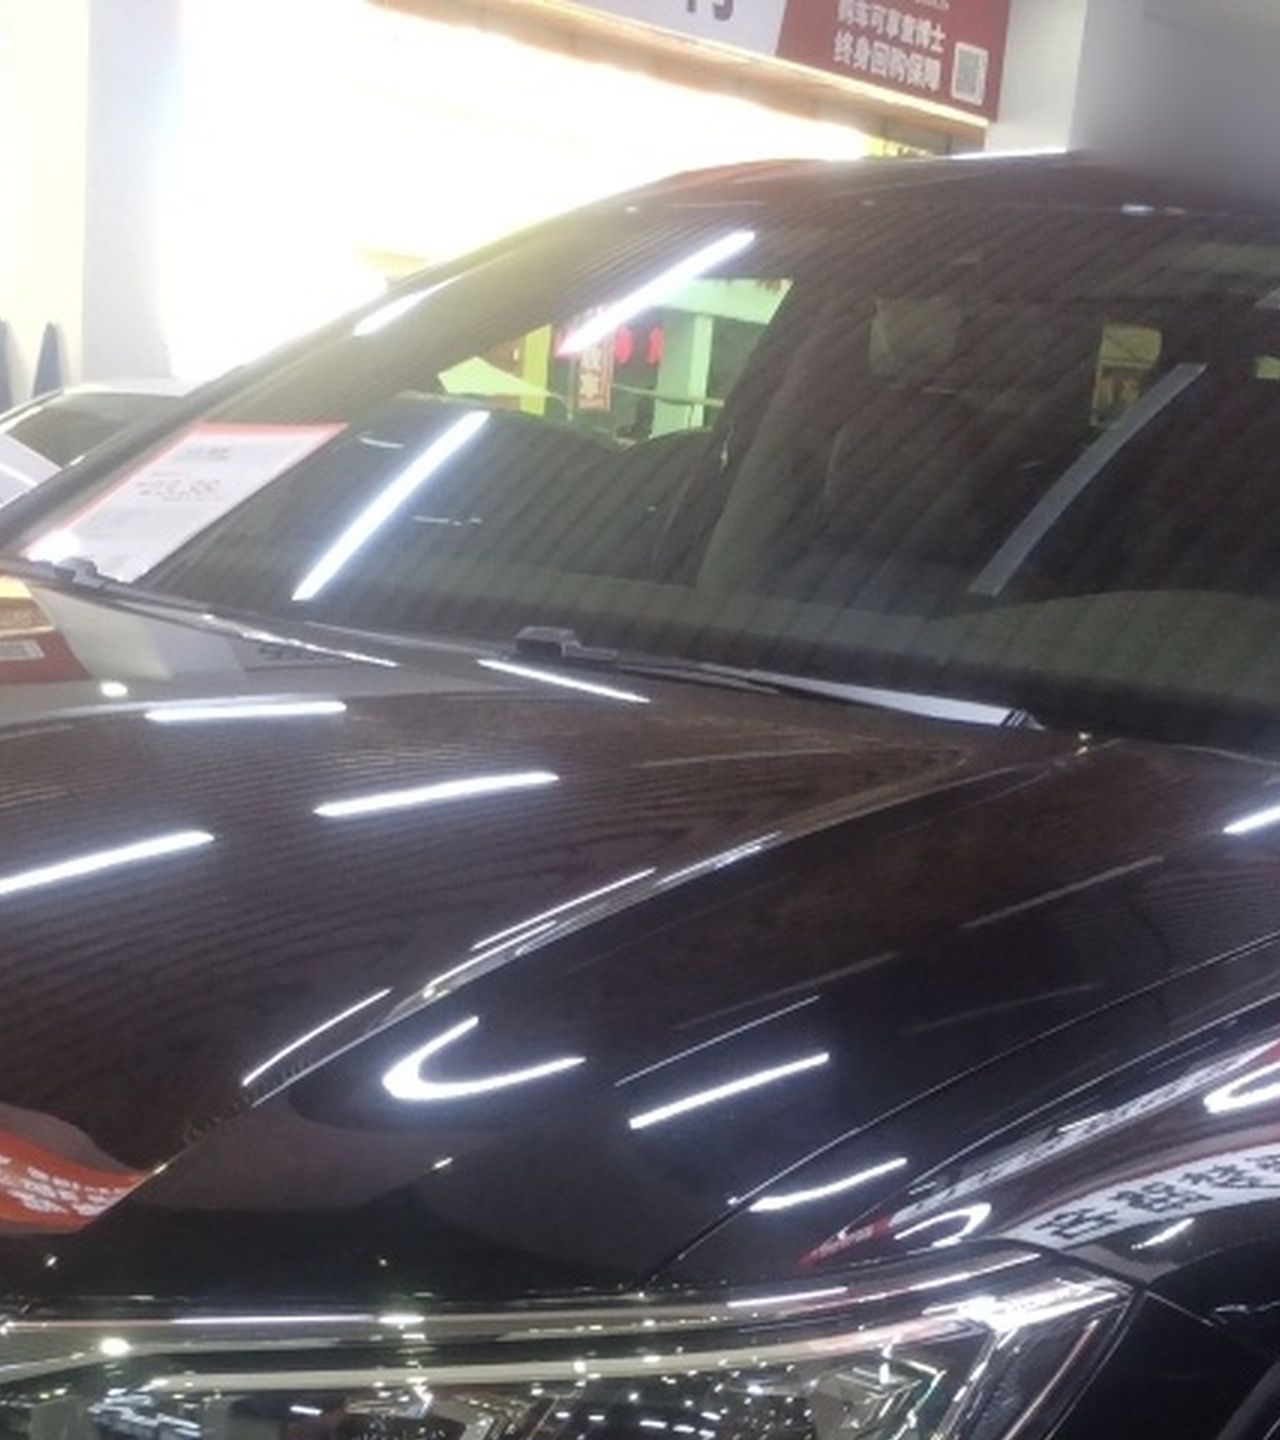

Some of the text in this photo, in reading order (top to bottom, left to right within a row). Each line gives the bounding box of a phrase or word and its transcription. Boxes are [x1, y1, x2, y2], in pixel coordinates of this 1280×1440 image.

[832, 29, 942, 92] 终身回购保障
